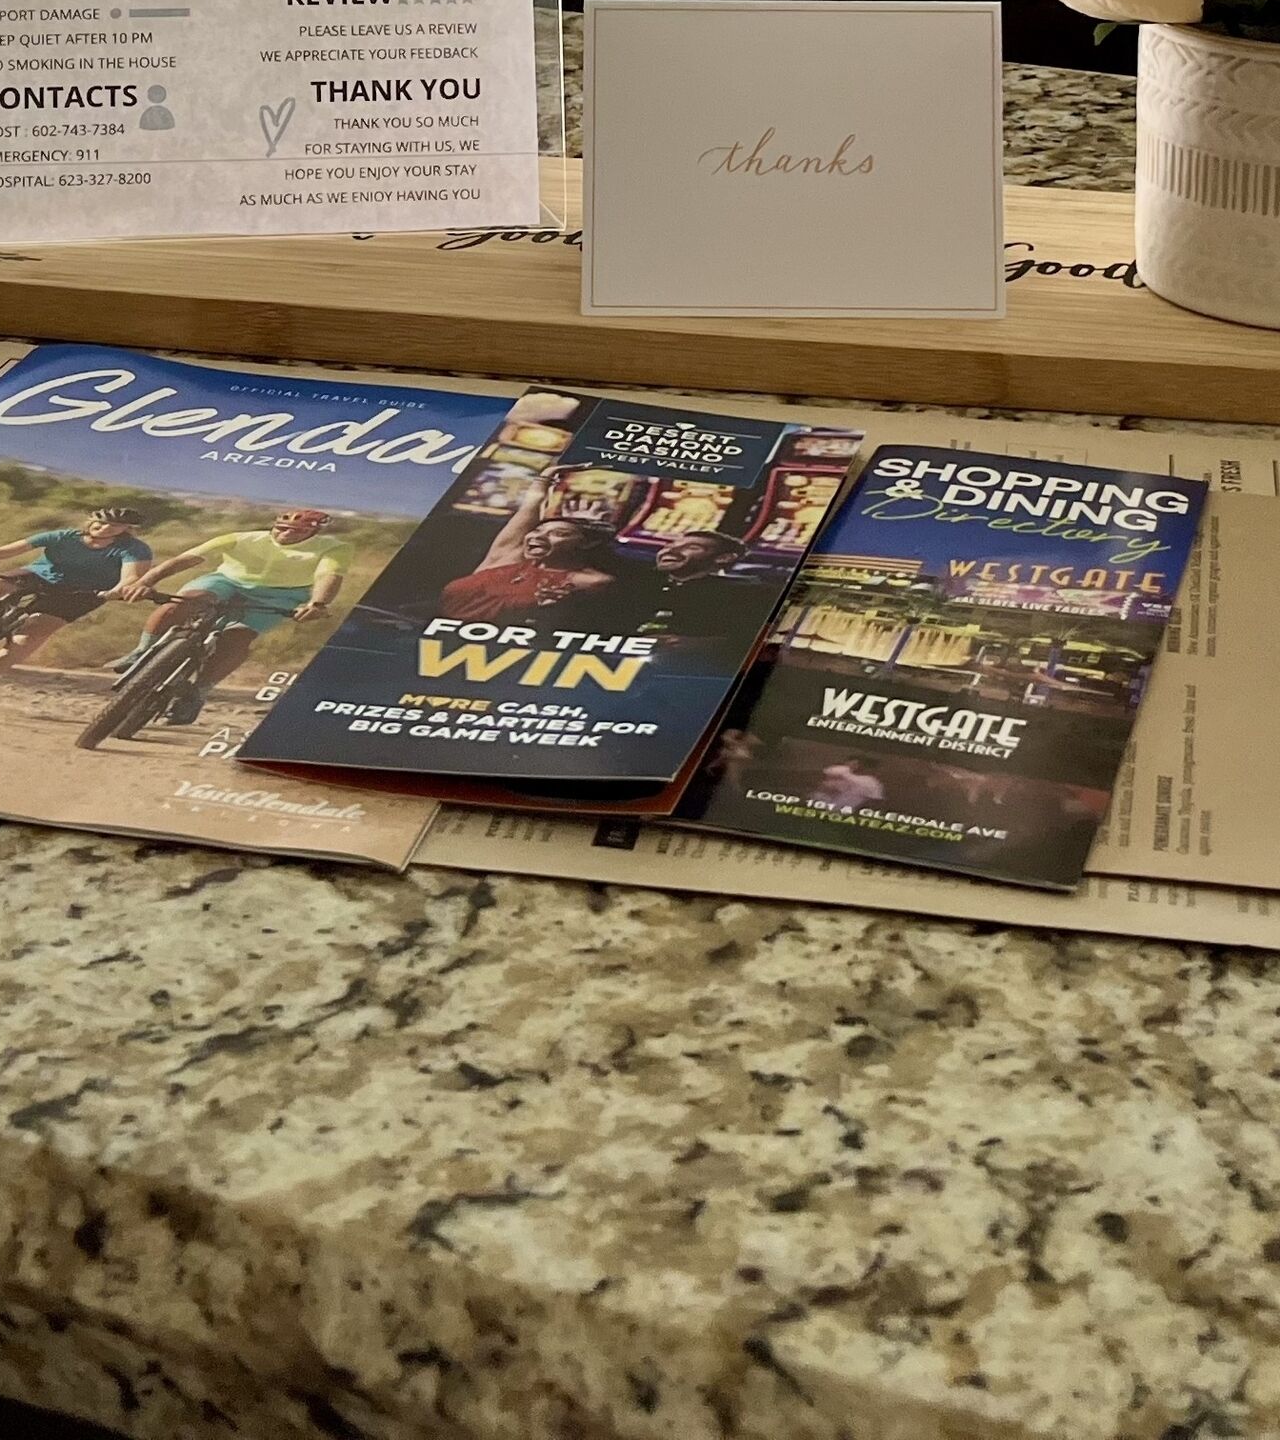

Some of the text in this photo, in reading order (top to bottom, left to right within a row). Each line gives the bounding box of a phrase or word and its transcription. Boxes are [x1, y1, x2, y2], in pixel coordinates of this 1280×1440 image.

[40, 9, 99, 20] DAMAGE
[20, 34, 61, 48] QUIET
[66, 33, 107, 44] AFTER
[113, 33, 127, 44] 10
[132, 32, 152, 43] PM
[300, 24, 477, 36] PLEASE LEAVE US A REVIEW
[8, 58, 74, 71] SMOKING
[80, 58, 93, 69] IN
[98, 58, 124, 69] THE
[129, 57, 176, 68] HOUSE
[260, 47, 478, 62] WE APPRECIATE YOUR FEEDBACK
[311, 78, 480, 102] THANK YOU
[32, 124, 124, 137] 602-743-7384
[334, 116, 478, 129] THANK YOU SO MUCH
[76, 149, 98, 160] 911
[305, 140, 479, 154] FOR STAYING WITH US, WE
[697, 126, 874, 176] thanks
[59, 173, 151, 186] 623-327-8200
[285, 165, 476, 180] HOPE YOU ENJOY YOUR STAY
[240, 195, 256, 206] AS
[261, 193, 302, 205] MUCH
[306, 193, 322, 204] AS
[327, 192, 347, 203] WE
[397, 189, 448, 201] HAVING
[452, 189, 480, 199] YOU
[230, 385, 428, 409] OFFICIAL TRAVEL GUIDE
[605, 430, 743, 455] DIAMOND
[625, 423, 736, 445] DESERT
[200, 450, 337, 473] ARIZONA
[600, 452, 724, 474] WEST VALLEY
[613, 441, 723, 462] CASINO
[873, 458, 1189, 515] SHOPPING
[886, 480, 1158, 532] & DINING
[861, 489, 1171, 564] Directory
[949, 559, 1167, 594] WESTGATE
[423, 618, 658, 655] FOR THE
[418, 638, 647, 691] WIN
[314, 701, 659, 736] PRIZES & PARTIES FOR
[497, 702, 589, 720] CASH,
[822, 687, 1027, 748] WESTGATE
[348, 719, 602, 748] BIG GAME WEEK
[806, 716, 1013, 760] ENTERTAINMENT DISTRICT
[745, 789, 801, 804] LOOP
[806, 799, 836, 811] 101
[859, 808, 965, 833] GLENDALE
[966, 825, 1009, 840] AVE
[774, 803, 965, 842] WESTGATEAZ.COM
